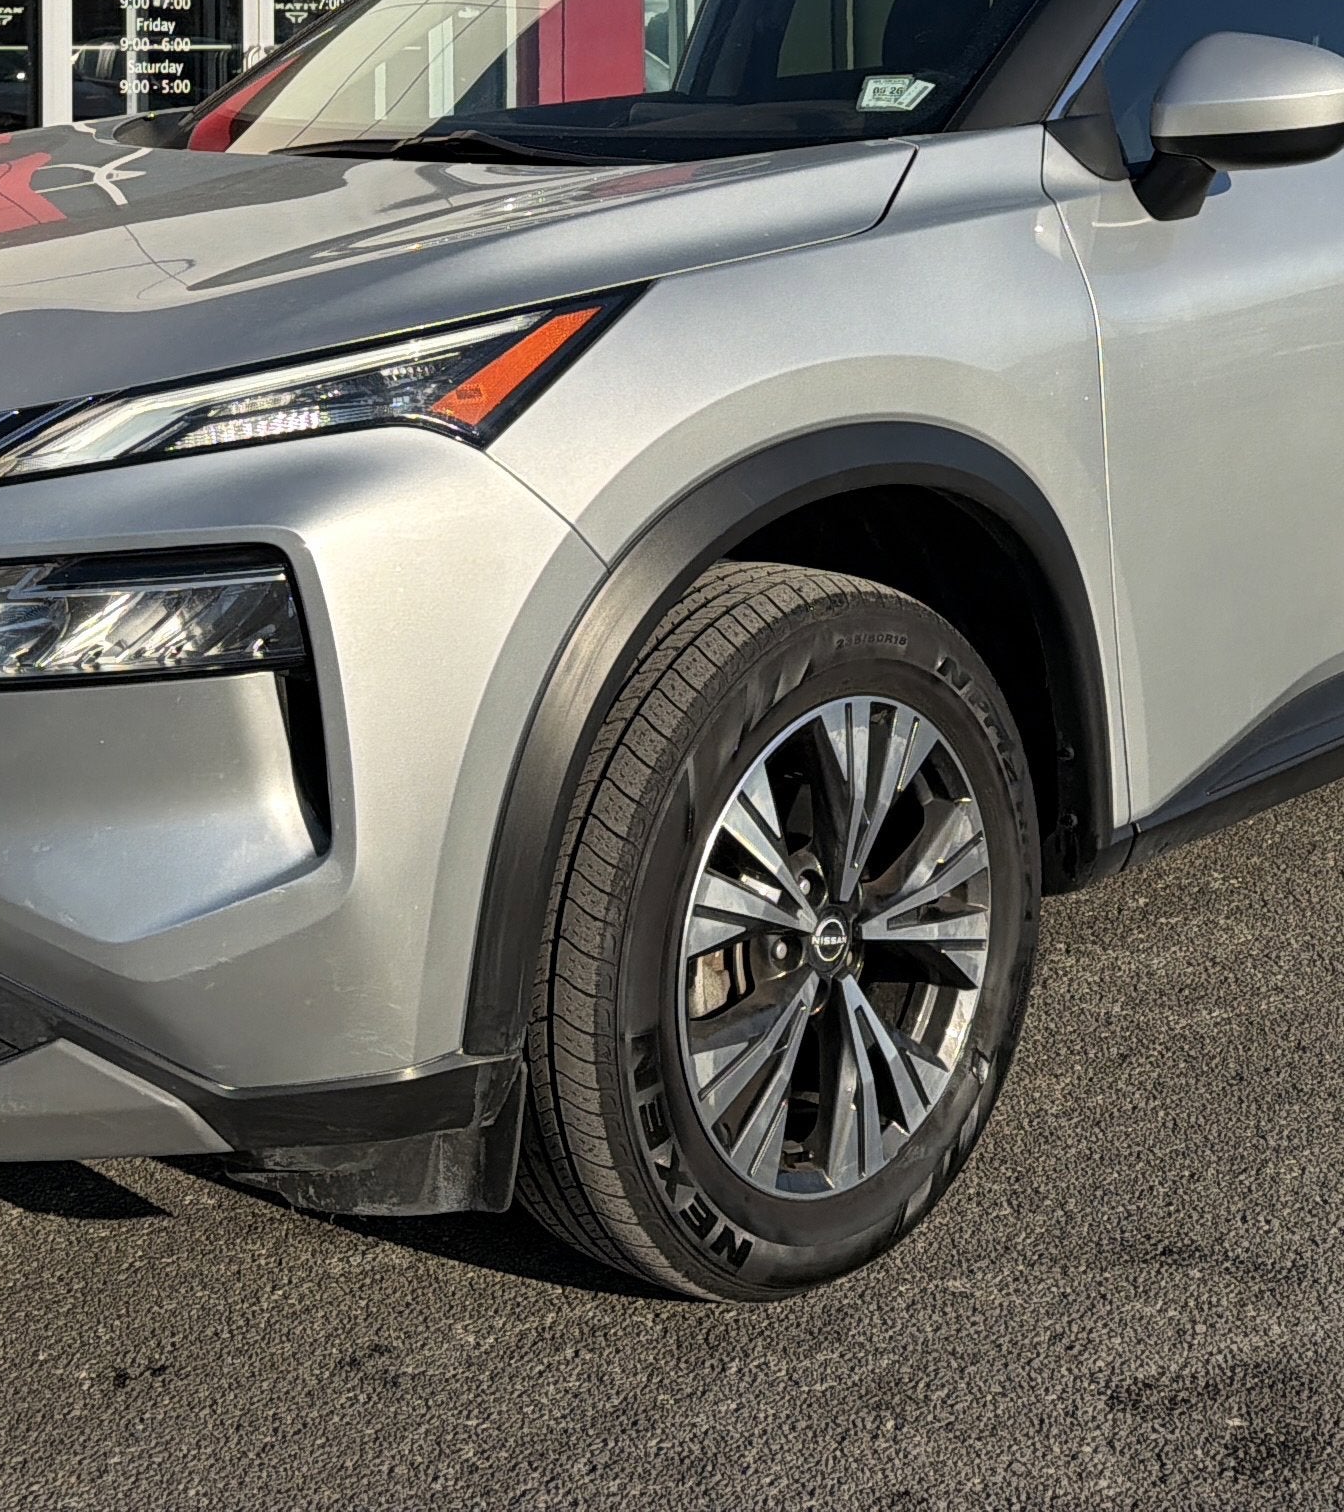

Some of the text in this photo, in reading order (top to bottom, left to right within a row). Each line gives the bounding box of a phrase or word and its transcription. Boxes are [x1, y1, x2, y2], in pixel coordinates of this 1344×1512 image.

[136, 17, 176, 35] Friday
[119, 37, 150, 52] 9:00
[161, 37, 191, 52] 6:00
[127, 59, 184, 77] Saturday
[119, 79, 150, 94] 9:00
[161, 79, 191, 94] 5:00
[811, 936, 847, 945] NISSAN
